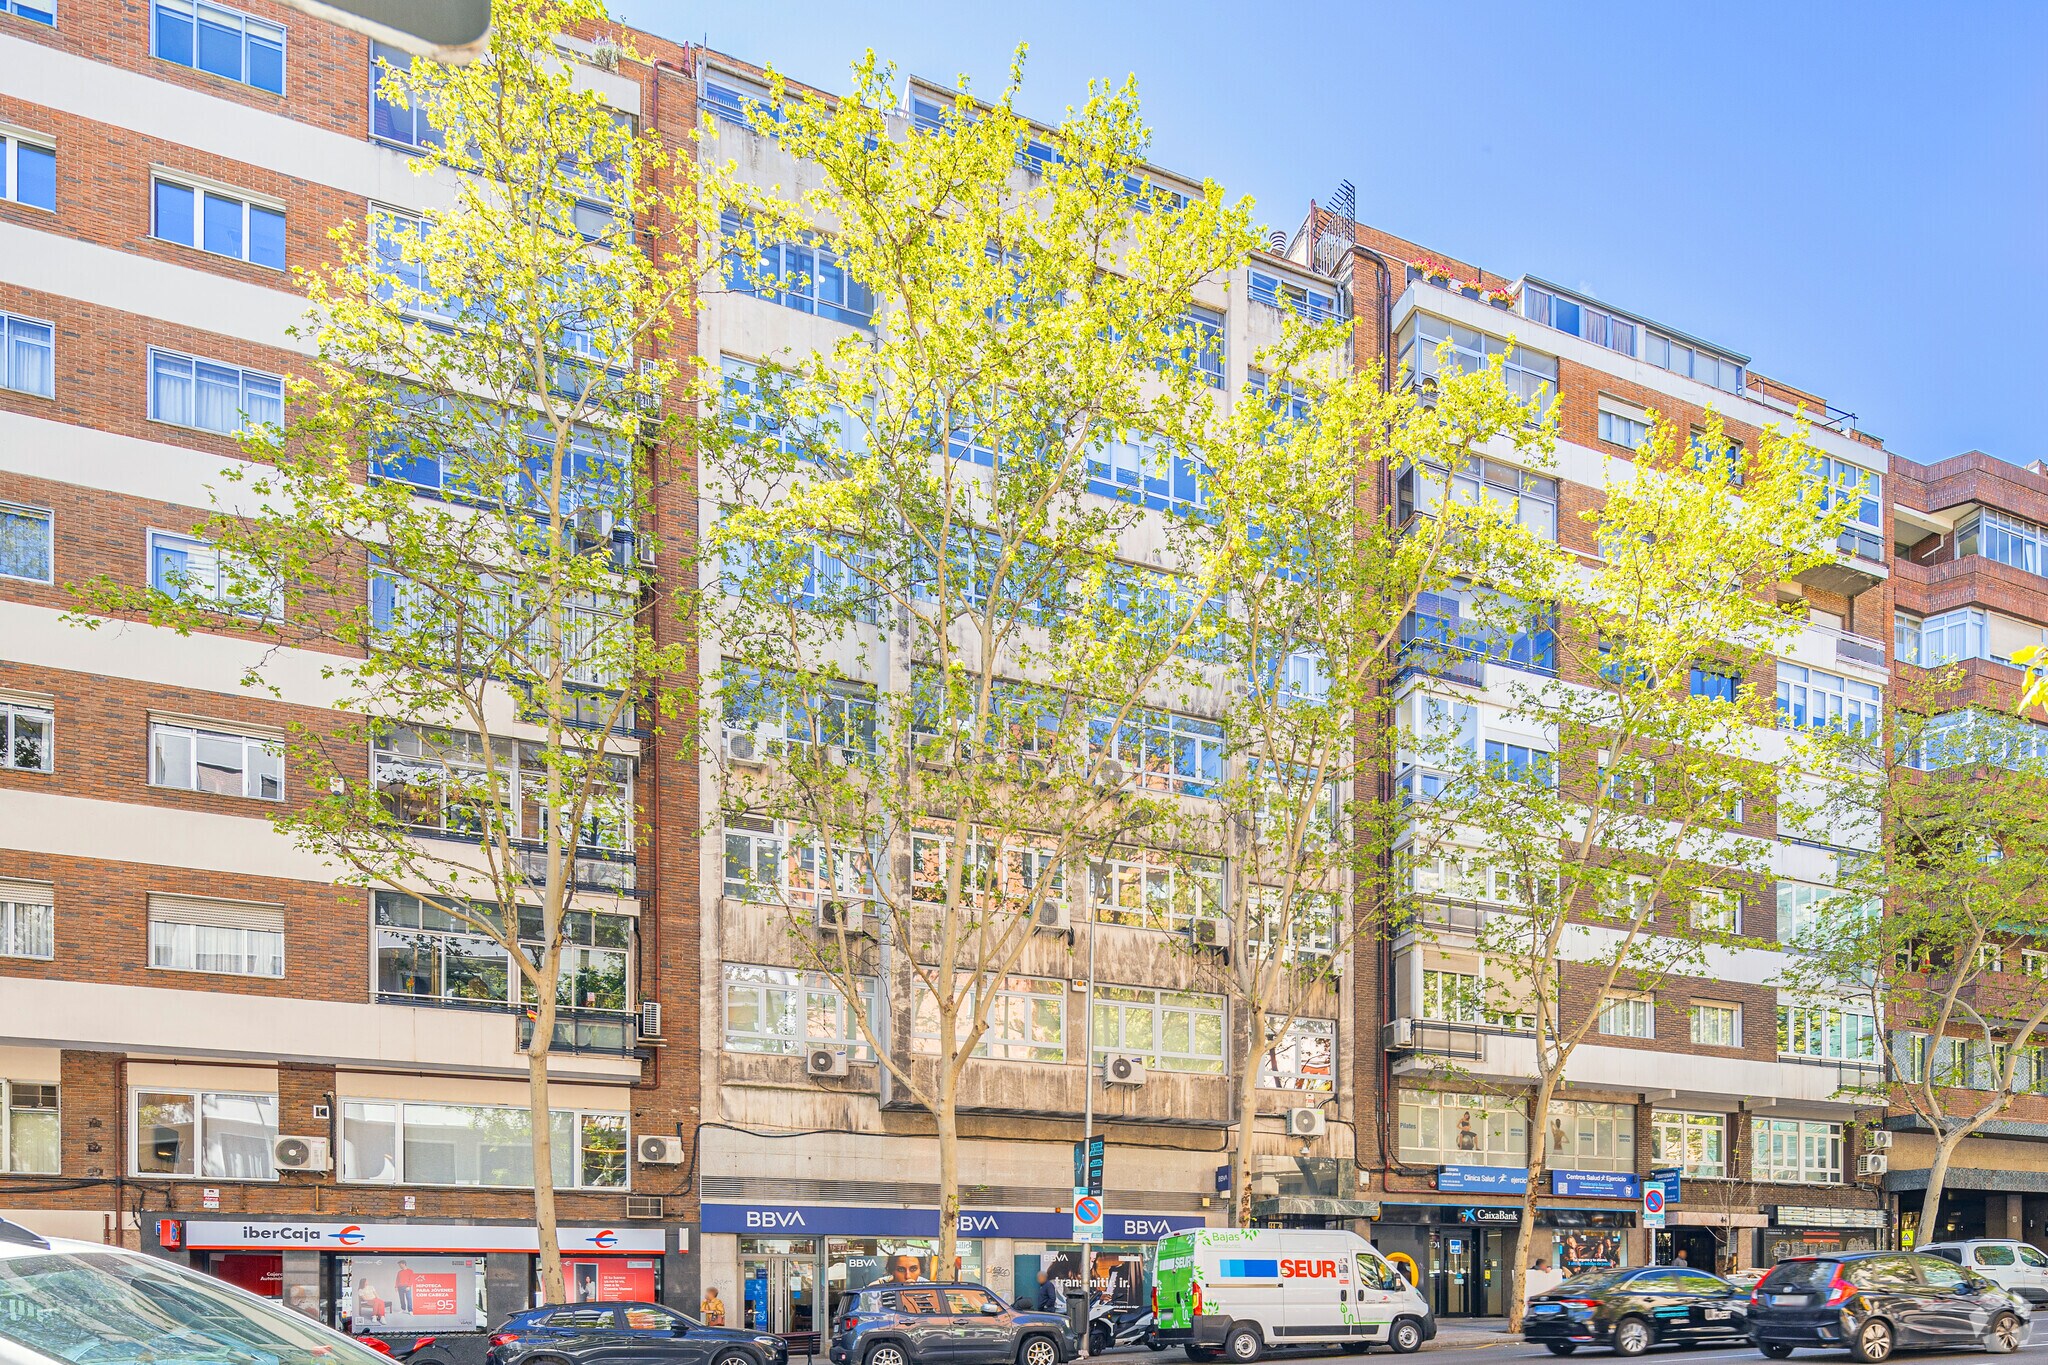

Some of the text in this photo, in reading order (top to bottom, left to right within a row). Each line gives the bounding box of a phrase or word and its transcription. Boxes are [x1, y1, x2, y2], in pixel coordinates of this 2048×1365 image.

[1400, 1122, 1417, 1130] Pilates
[1481, 1175, 1496, 1183] Salud
[1566, 1173, 1586, 1181] Centros
[1606, 1175, 1627, 1183] Ejercicio
[746, 1210, 806, 1228] BBVA
[1477, 1209, 1518, 1220] CaixaBank
[1124, 1219, 1172, 1235] BBVA
[243, 1226, 321, 1242] iberCaja
[1212, 1231, 1240, 1243] Bajas
[849, 1258, 877, 1268] BBVA
[1043, 1254, 1069, 1262] BBVA
[1175, 1256, 1194, 1269] SEUR
[1280, 1259, 1337, 1278] SEUR
[436, 1299, 454, 1311] 95
